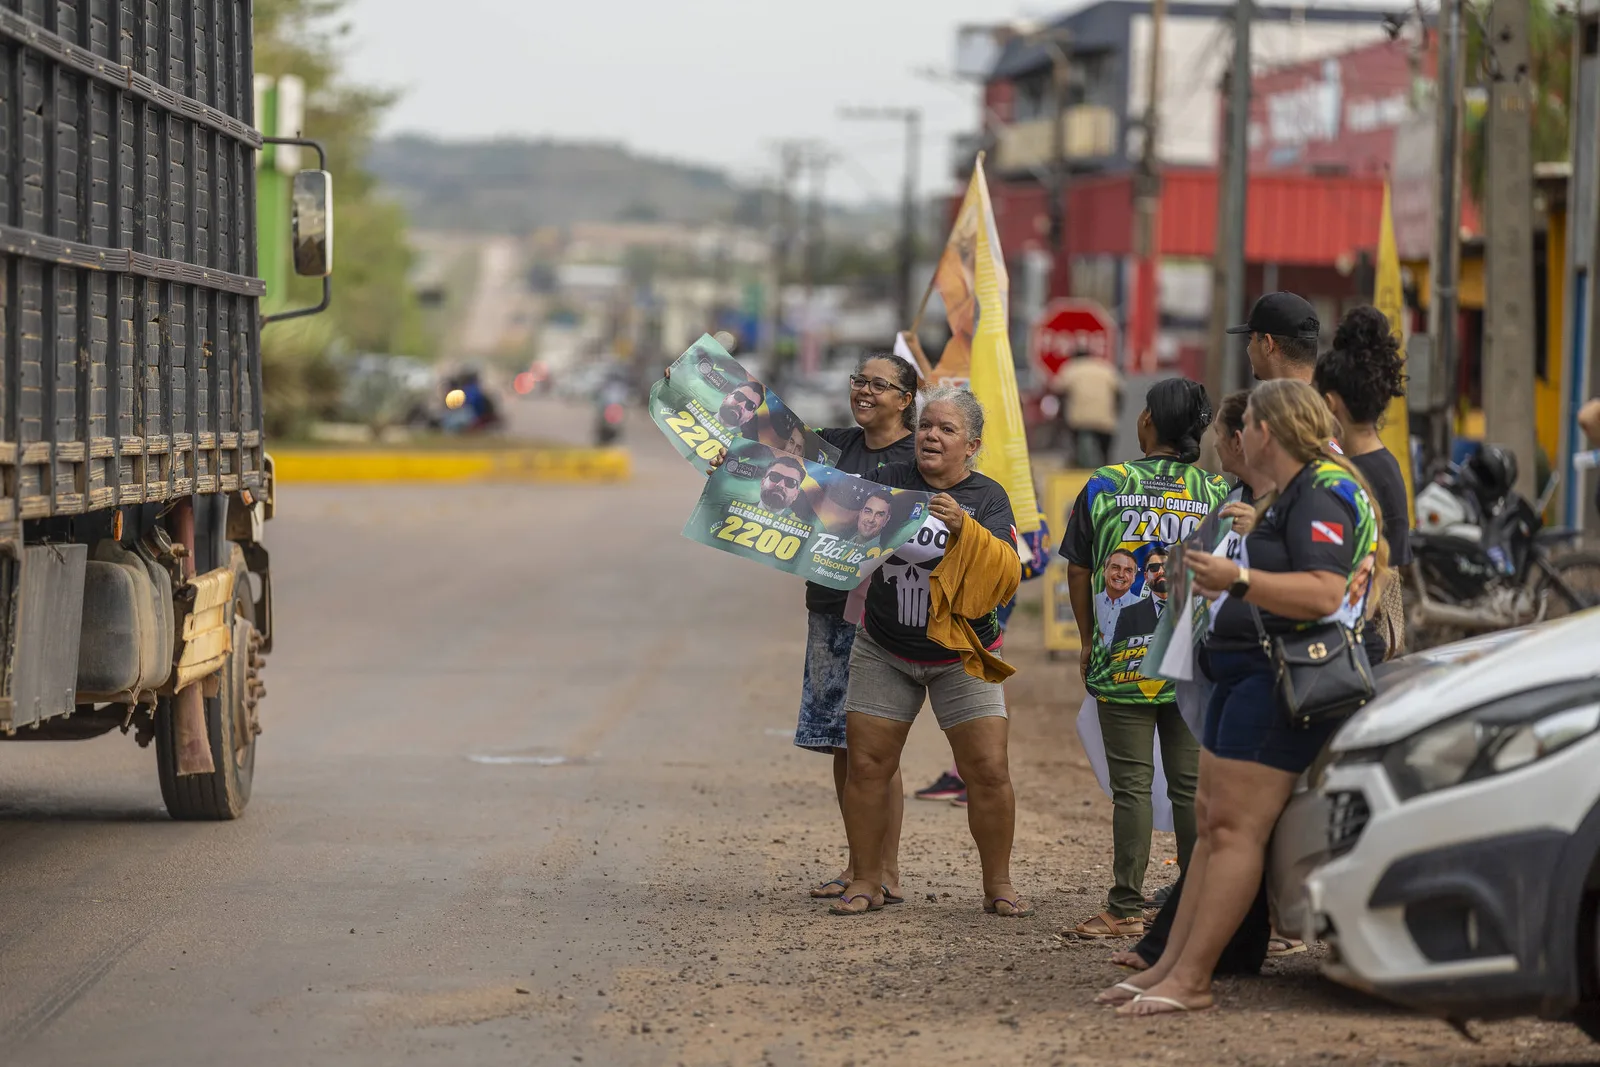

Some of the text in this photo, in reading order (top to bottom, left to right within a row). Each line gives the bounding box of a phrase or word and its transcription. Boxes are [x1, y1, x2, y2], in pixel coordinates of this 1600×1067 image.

[685, 402, 721, 437] DELEGADO
[691, 399, 725, 432] DEPUTADO
[665, 411, 725, 470] 220
[731, 500, 812, 532] DEPUTADO FEDERAL
[1115, 494, 1209, 515] TROPA DO CAVEIRA
[716, 515, 801, 560] 2200
[728, 505, 811, 539] DELEGADO CAVEIRA
[907, 526, 950, 549] 00
[810, 533, 866, 564] Flávio
[812, 553, 856, 573] Bolsonaro
[1127, 634, 1154, 648] DE
